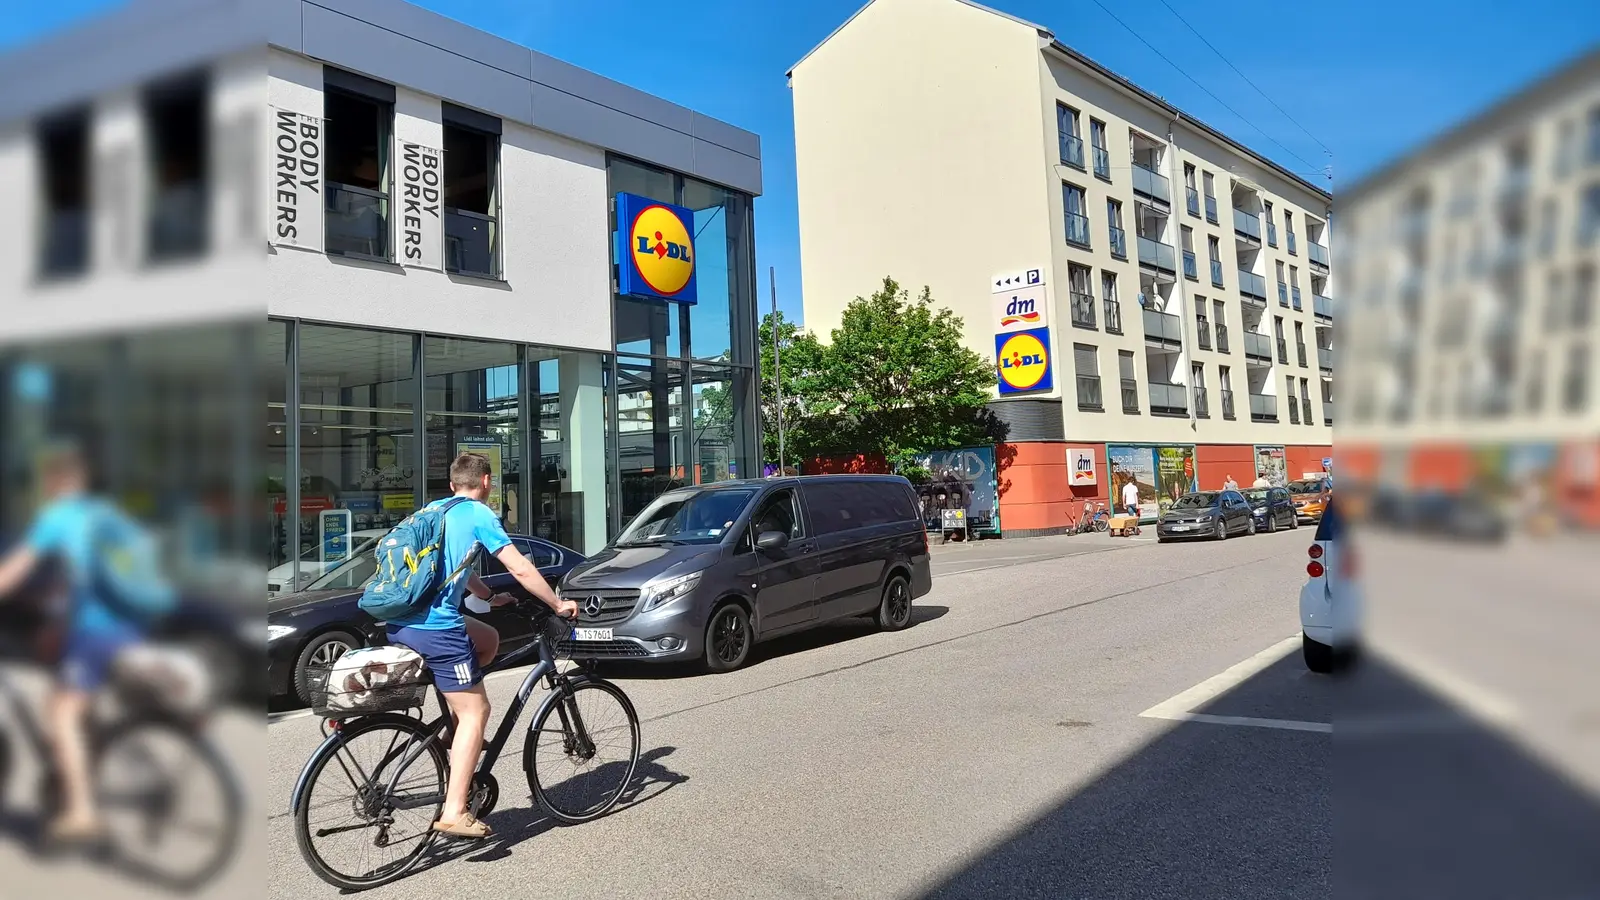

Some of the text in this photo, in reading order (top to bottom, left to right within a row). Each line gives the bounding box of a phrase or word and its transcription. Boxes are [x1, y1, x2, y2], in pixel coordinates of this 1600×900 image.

[300, 114, 319, 125] THE
[300, 122, 319, 194] BODY
[422, 147, 438, 155] THE
[276, 111, 297, 239] WORKERS
[422, 154, 439, 218] BODY
[403, 144, 422, 260] WORKERS
[1028, 270, 1038, 283] P
[1006, 296, 1035, 316] dm
[1077, 454, 1091, 470] dm
